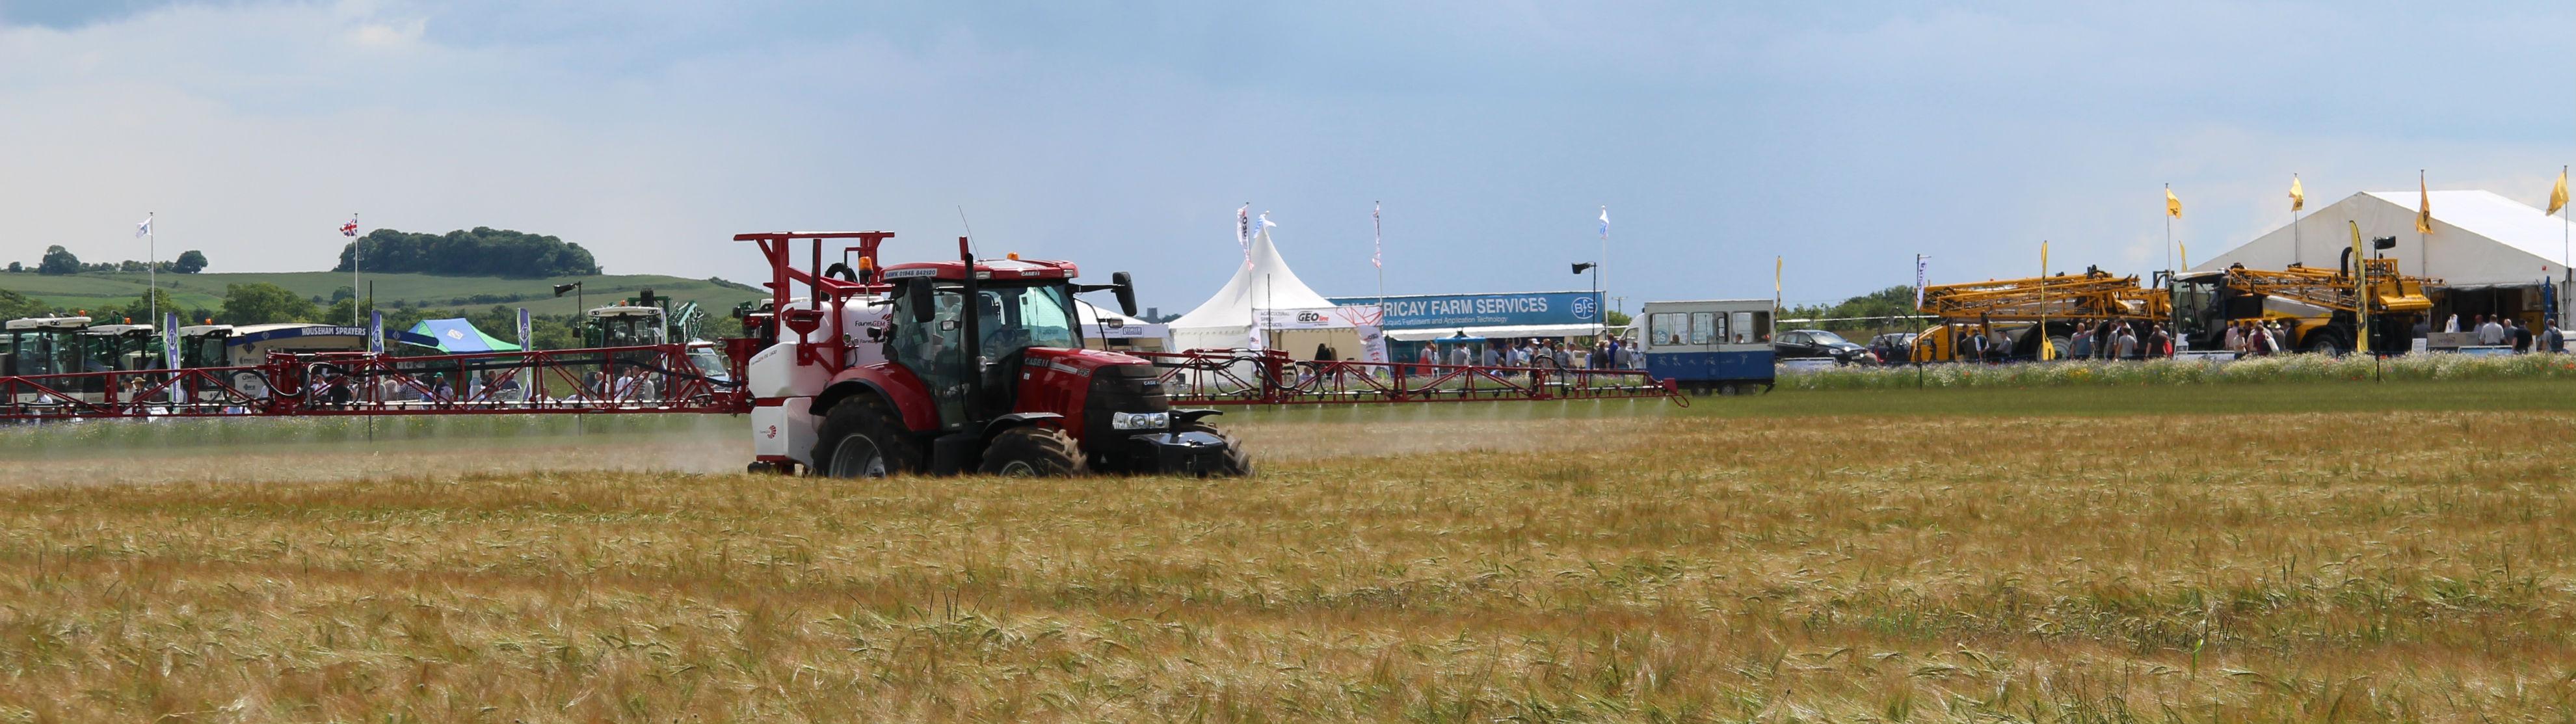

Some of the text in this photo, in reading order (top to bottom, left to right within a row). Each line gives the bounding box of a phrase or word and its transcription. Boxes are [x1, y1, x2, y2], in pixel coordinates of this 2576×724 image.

[1431, 299, 1473, 315] FARM
[1476, 297, 1548, 314] SERVICES
[1476, 315, 1508, 324] Technology
[302, 327, 334, 336] HOUSEHAM
